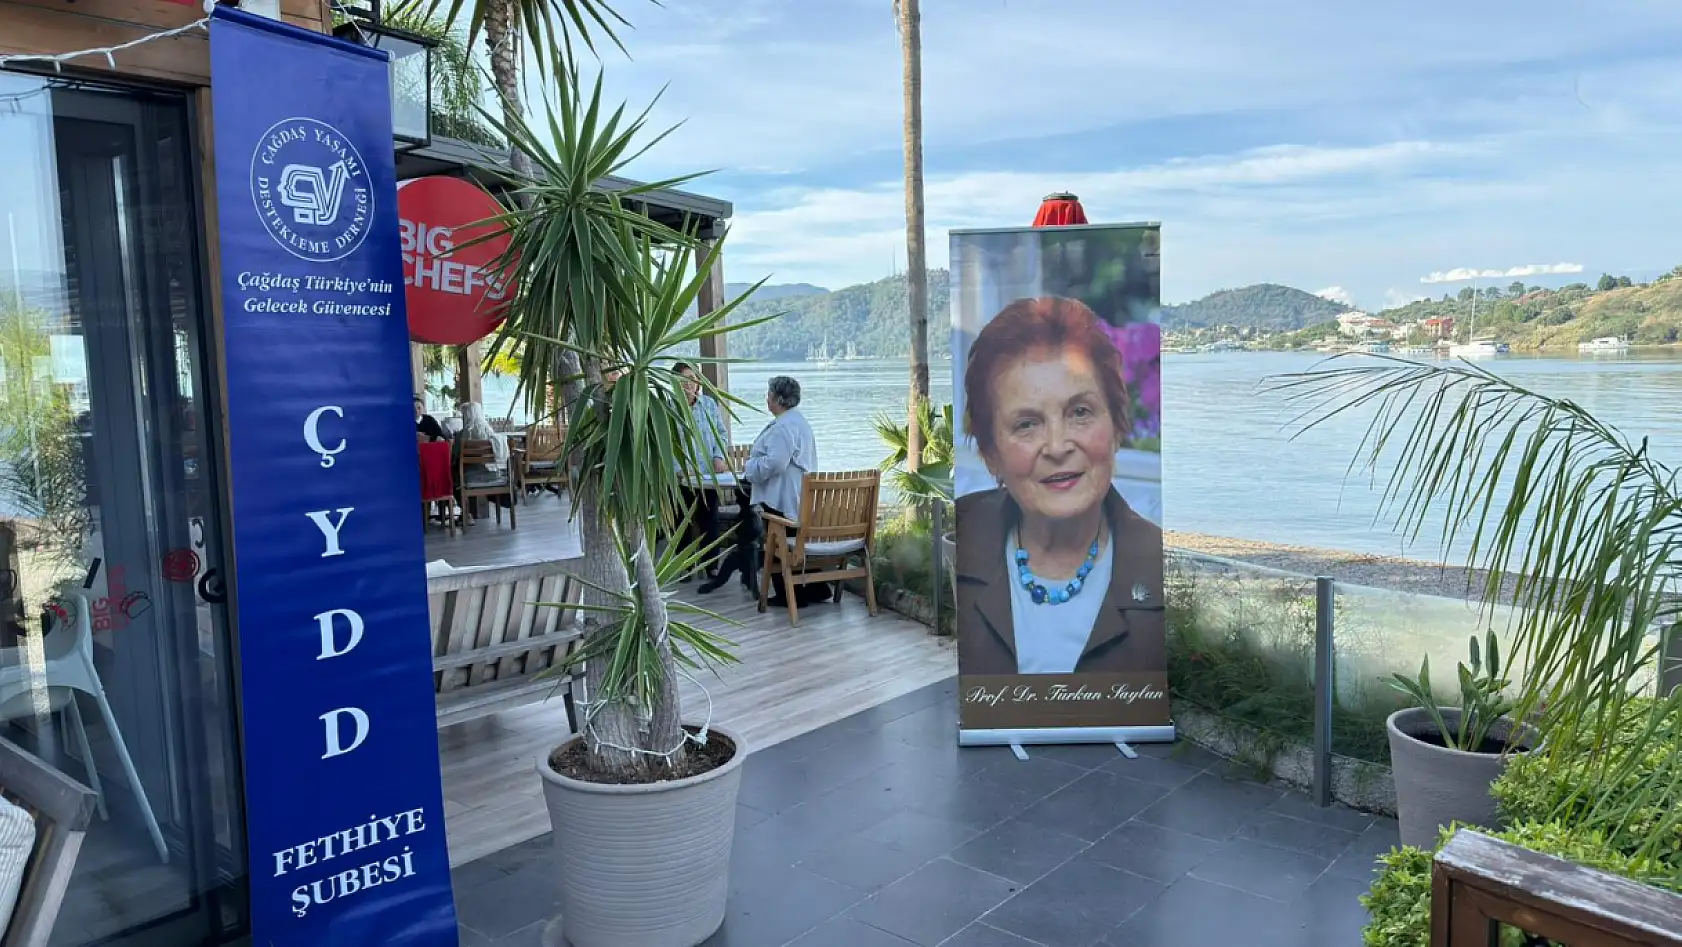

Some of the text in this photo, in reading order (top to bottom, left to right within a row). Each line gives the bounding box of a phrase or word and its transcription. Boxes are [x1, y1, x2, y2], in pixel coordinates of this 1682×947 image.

[262, 126, 362, 177] ÇAĞDAŞ YAŞAMI
[258, 176, 367, 254] DESTEKLEME DERNEĞİ
[399, 218, 454, 258] BIG
[237, 271, 393, 296] Çağdaş Türkiye'nin
[244, 298, 392, 316] Gelecek Güvencesi
[965, 682, 1164, 707] Prof. Dr. Türkan Saylan
[272, 807, 426, 877] FETHİYE
[291, 846, 417, 918] ŞUBESİ
